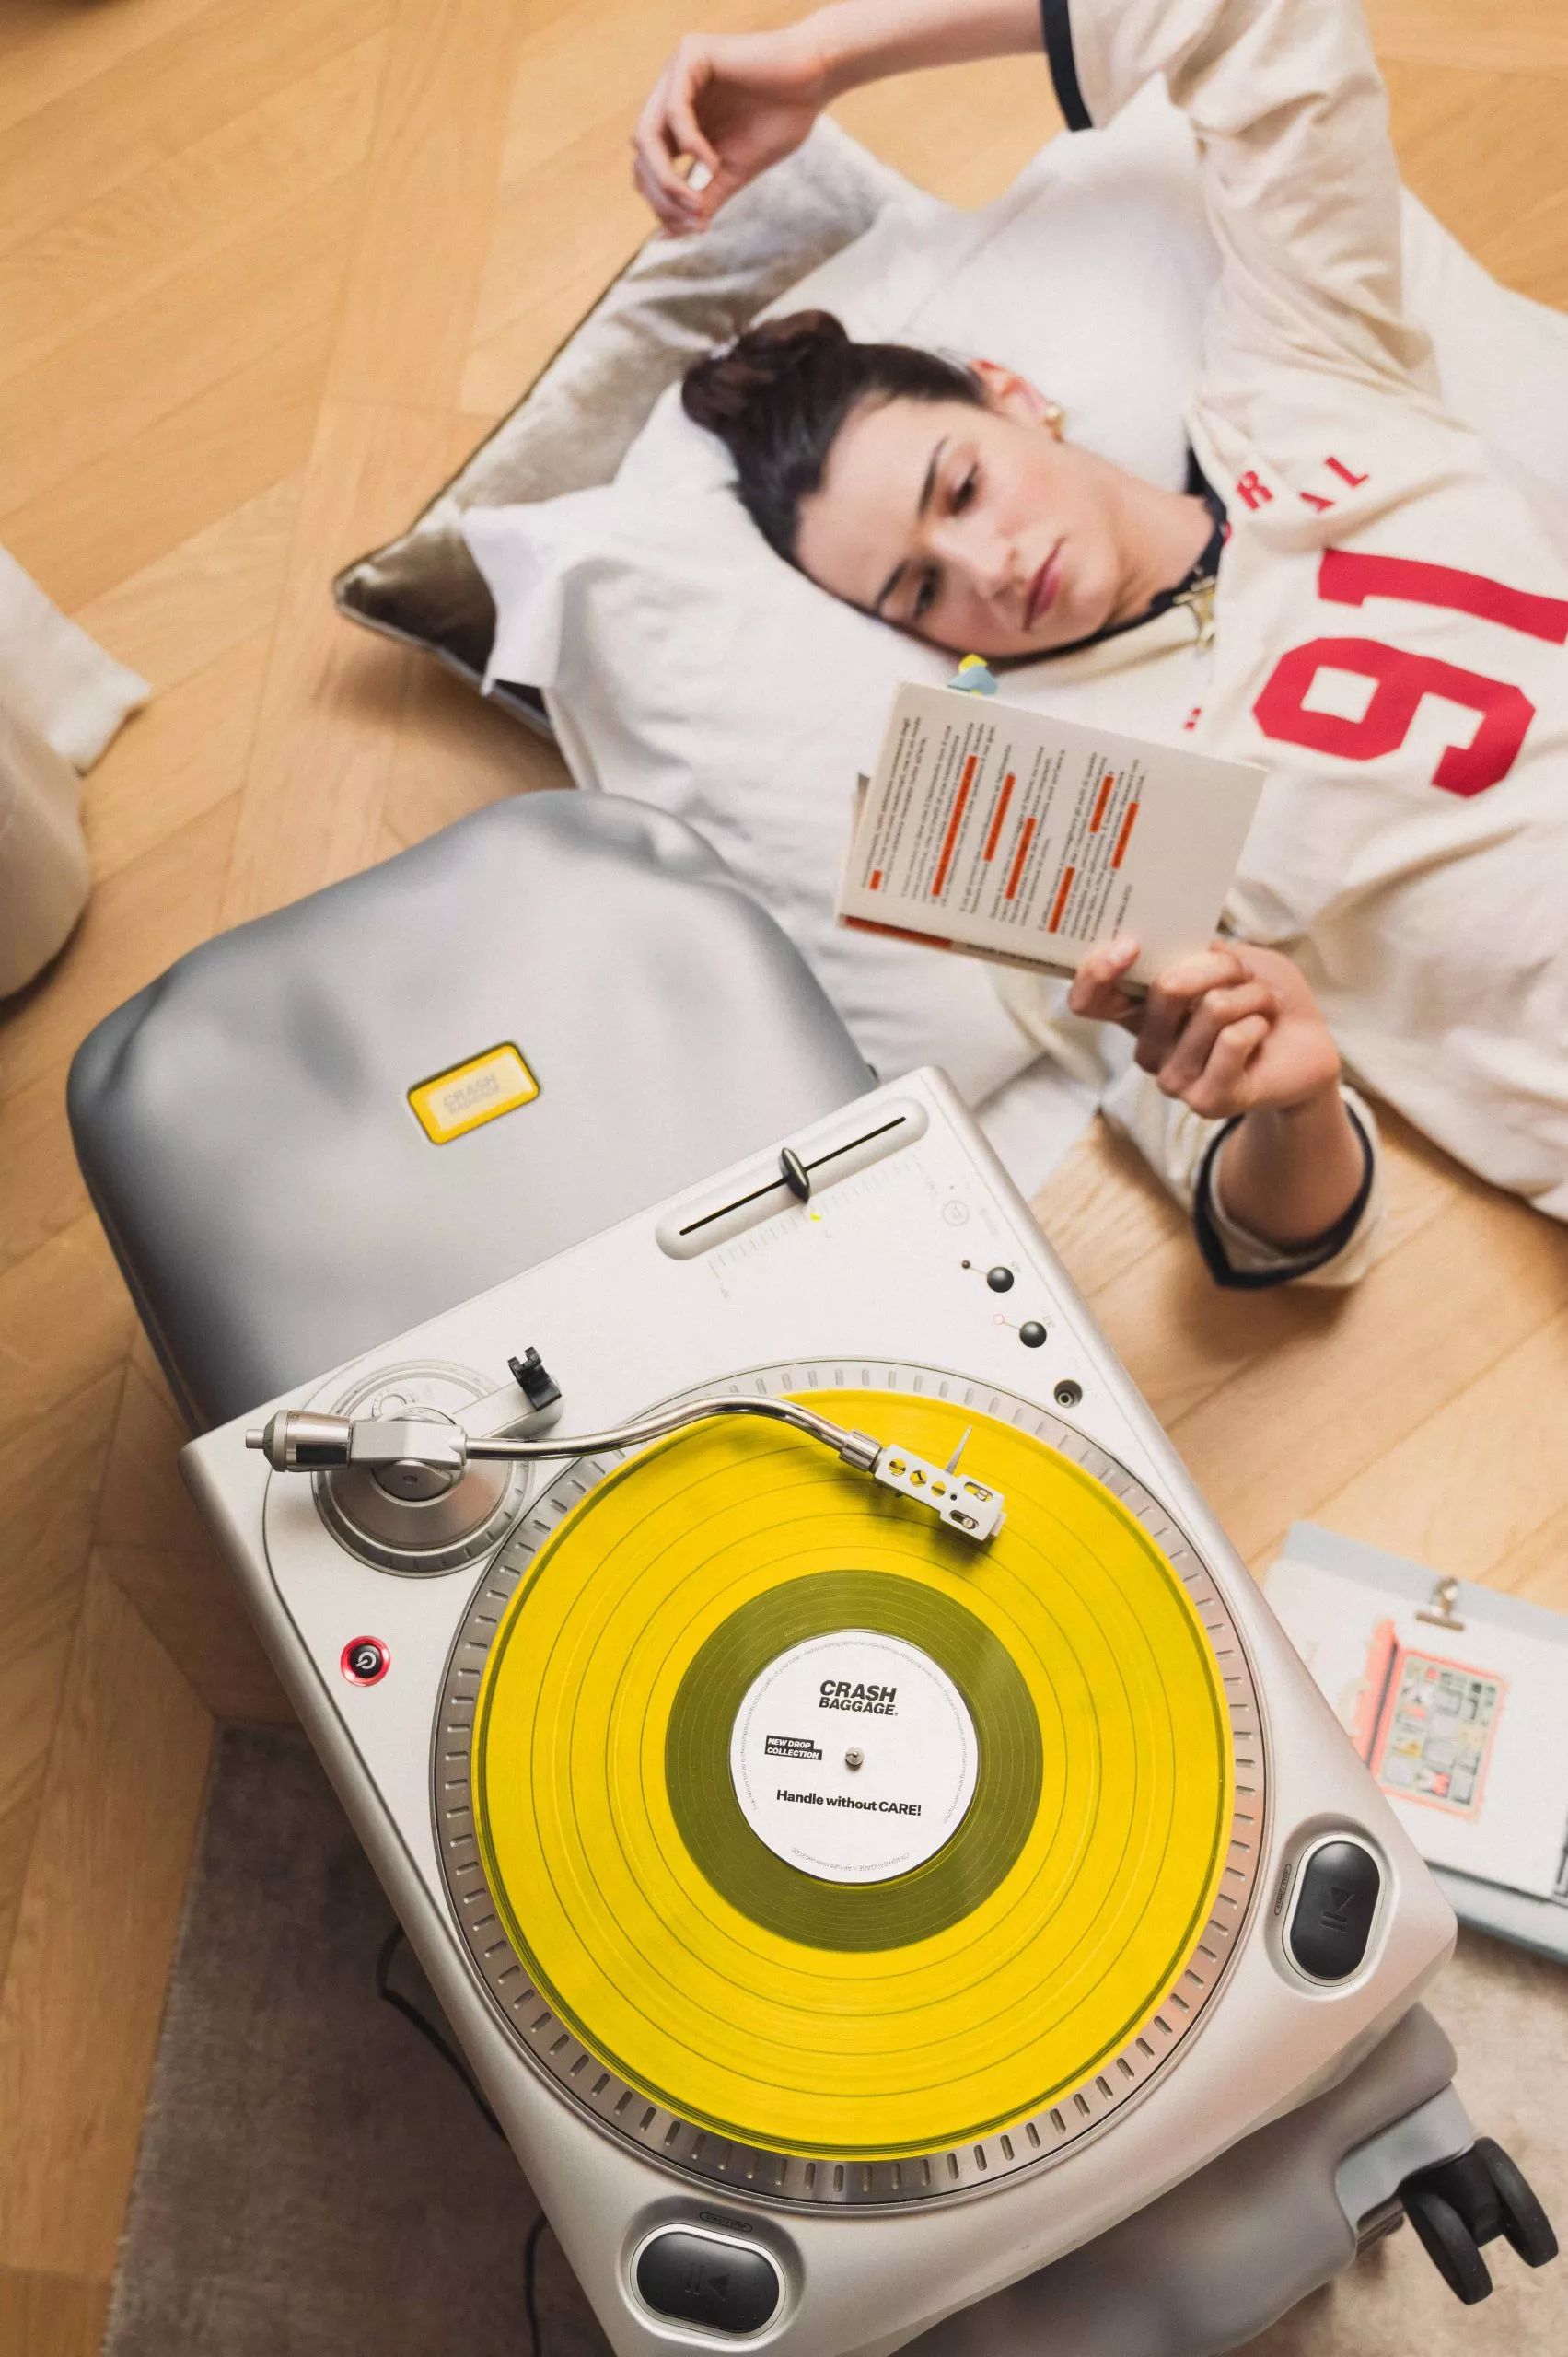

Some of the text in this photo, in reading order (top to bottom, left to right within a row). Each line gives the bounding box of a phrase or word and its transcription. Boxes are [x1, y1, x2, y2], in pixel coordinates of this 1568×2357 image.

[1252, 547, 1568, 799] 91
[819, 1680, 897, 1702] CRASH
[767, 1747, 819, 1759] COLLECTION
[768, 1738, 787, 1747] NEW
[776, 1789, 922, 1817] Handle without CARE!
